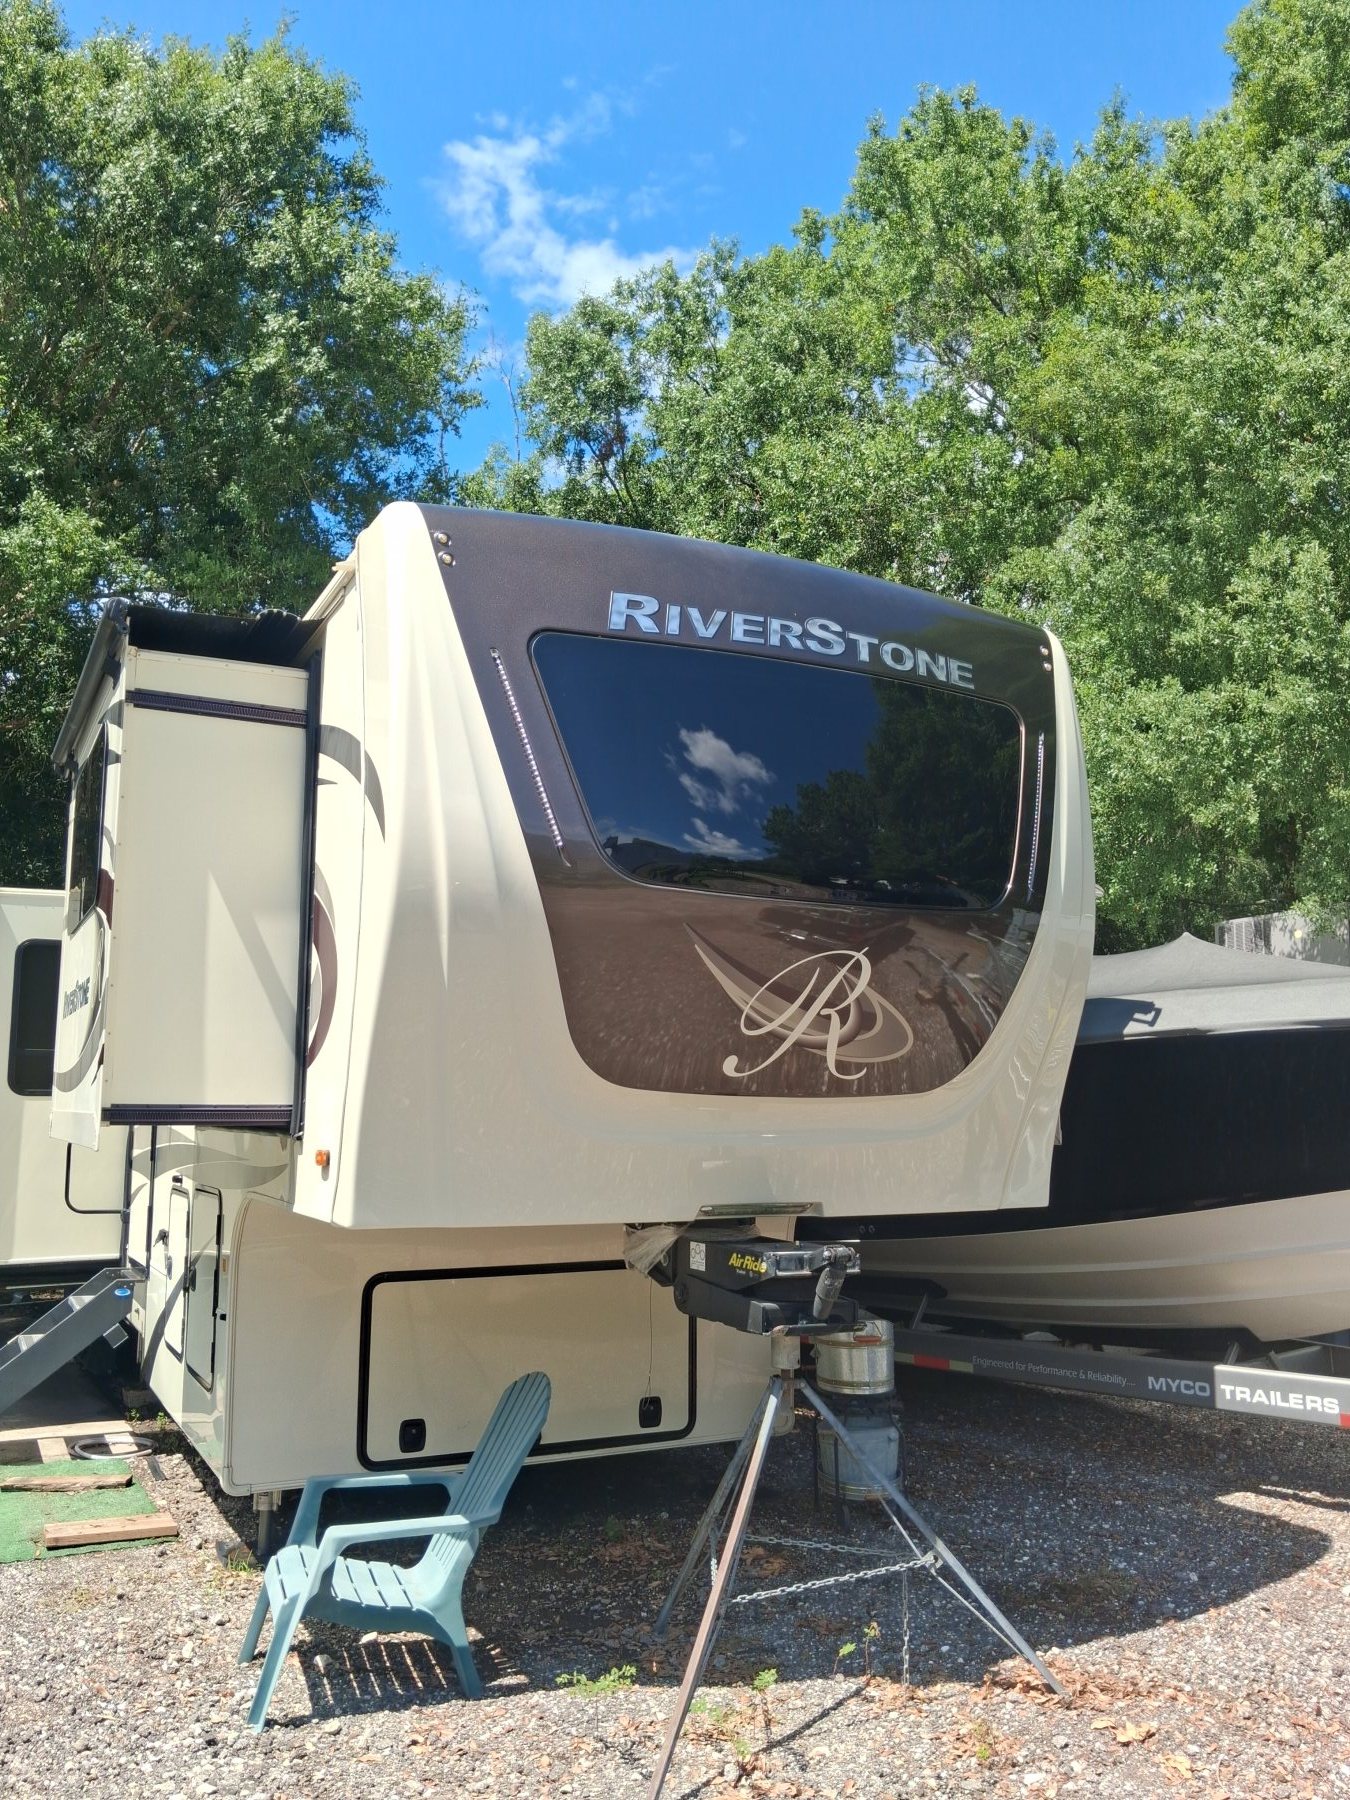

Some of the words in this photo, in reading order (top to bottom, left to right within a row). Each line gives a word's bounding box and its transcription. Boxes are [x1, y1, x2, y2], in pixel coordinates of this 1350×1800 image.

[722, 946, 871, 1080] R
[972, 1355, 1014, 1369] Engineered
[1015, 1361, 1026, 1371] for
[1027, 1363, 1078, 1378] Performance
[1079, 1369, 1086, 1379] &
[1147, 1376, 1211, 1397] MYCO
[1220, 1384, 1340, 1414] TRAILERS
